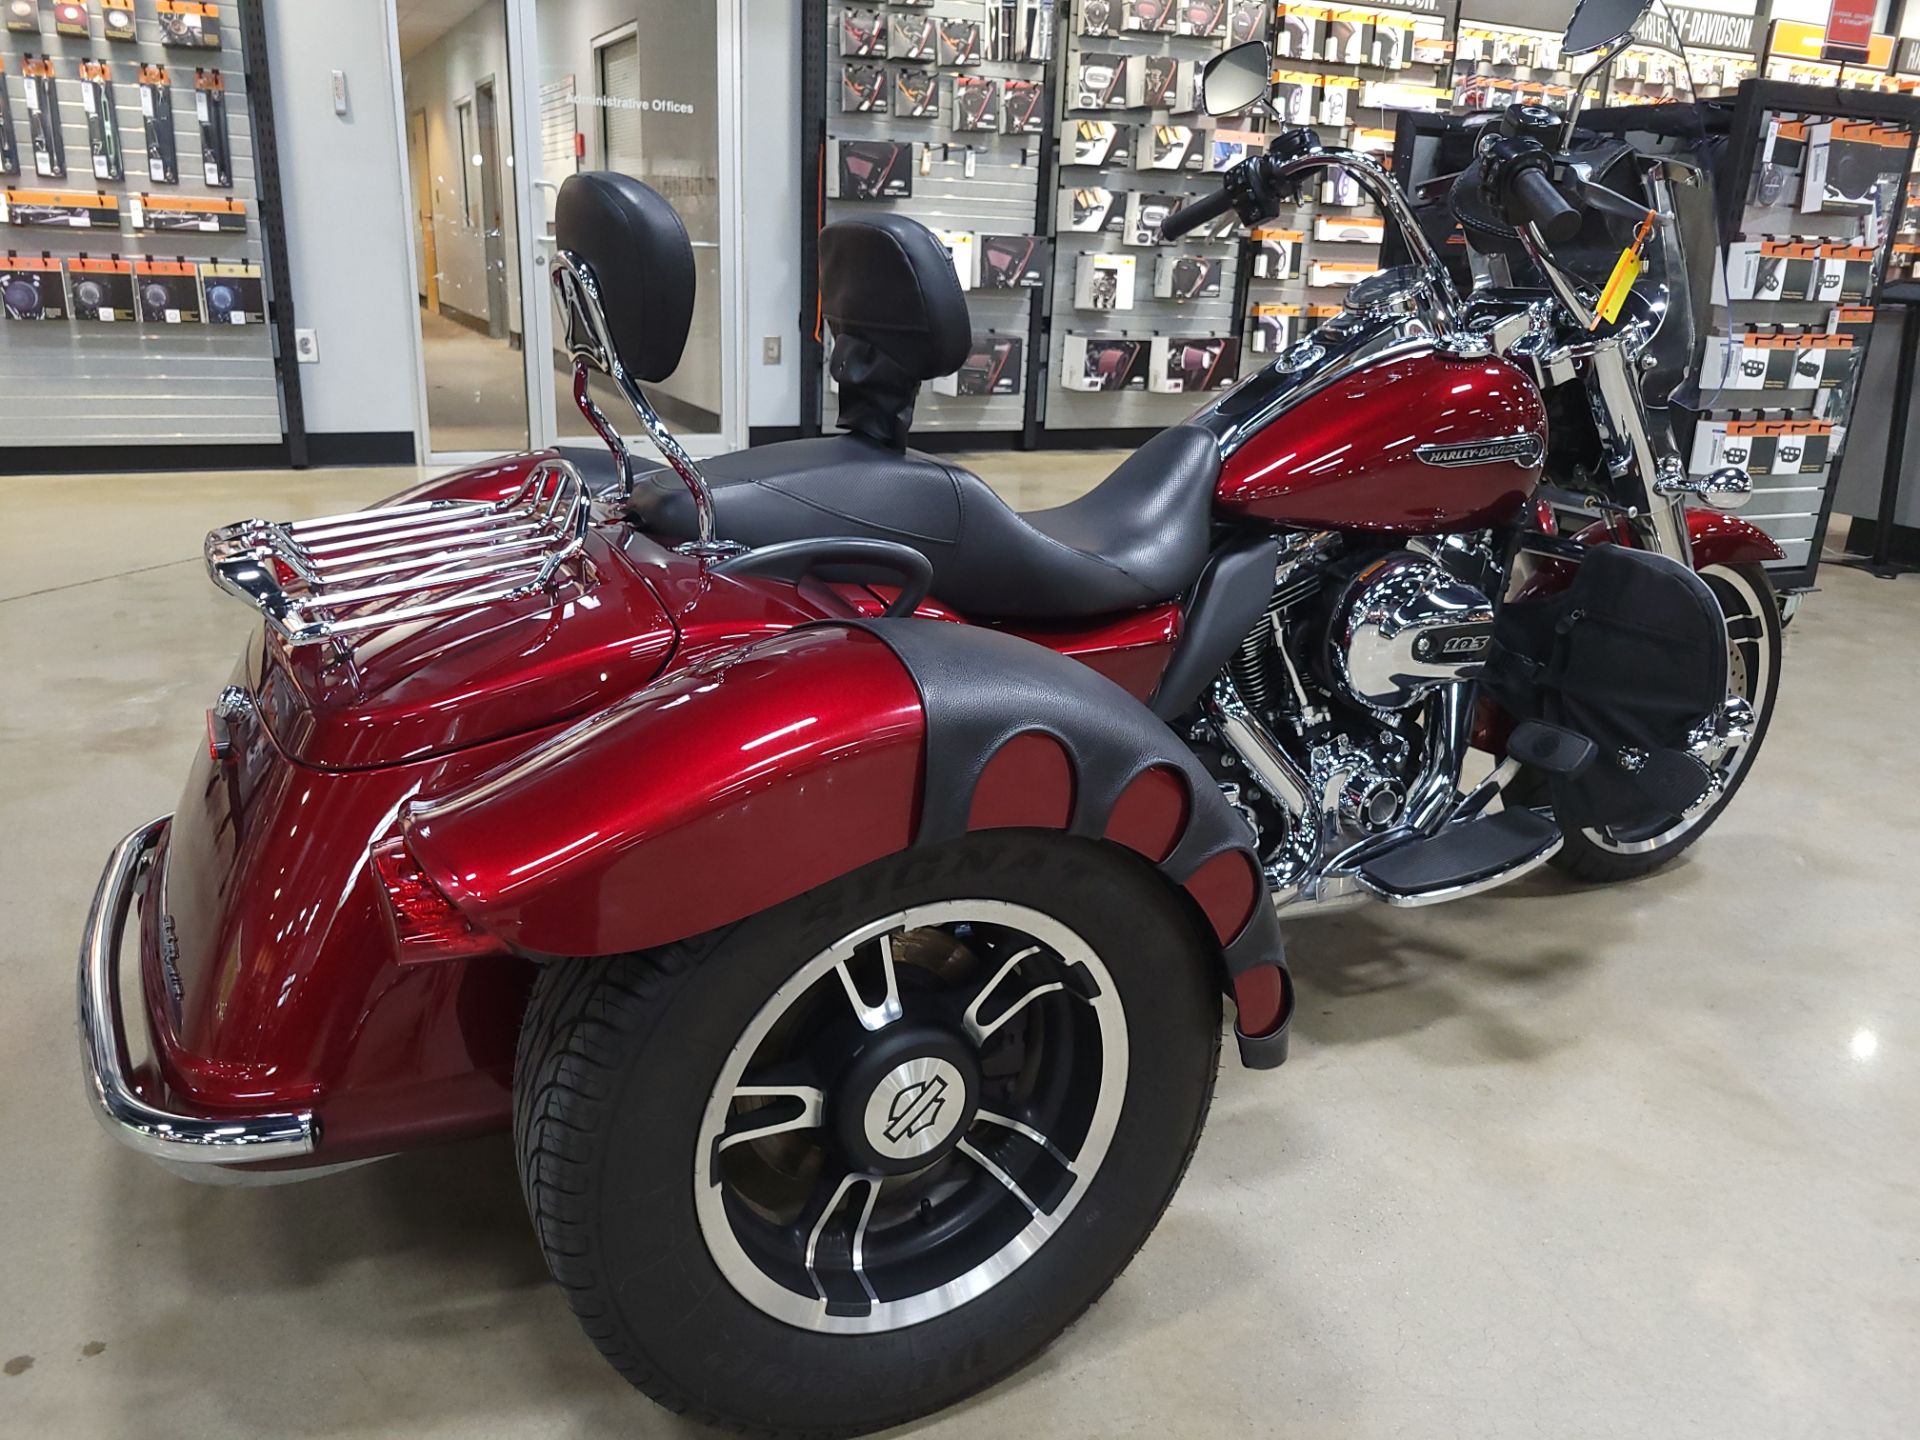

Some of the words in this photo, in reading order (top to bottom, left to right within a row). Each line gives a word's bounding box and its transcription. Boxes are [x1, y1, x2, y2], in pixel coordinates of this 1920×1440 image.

[566, 93, 649, 110] Administrative
[651, 99, 694, 114] Offices
[1442, 635, 1491, 653] 103
